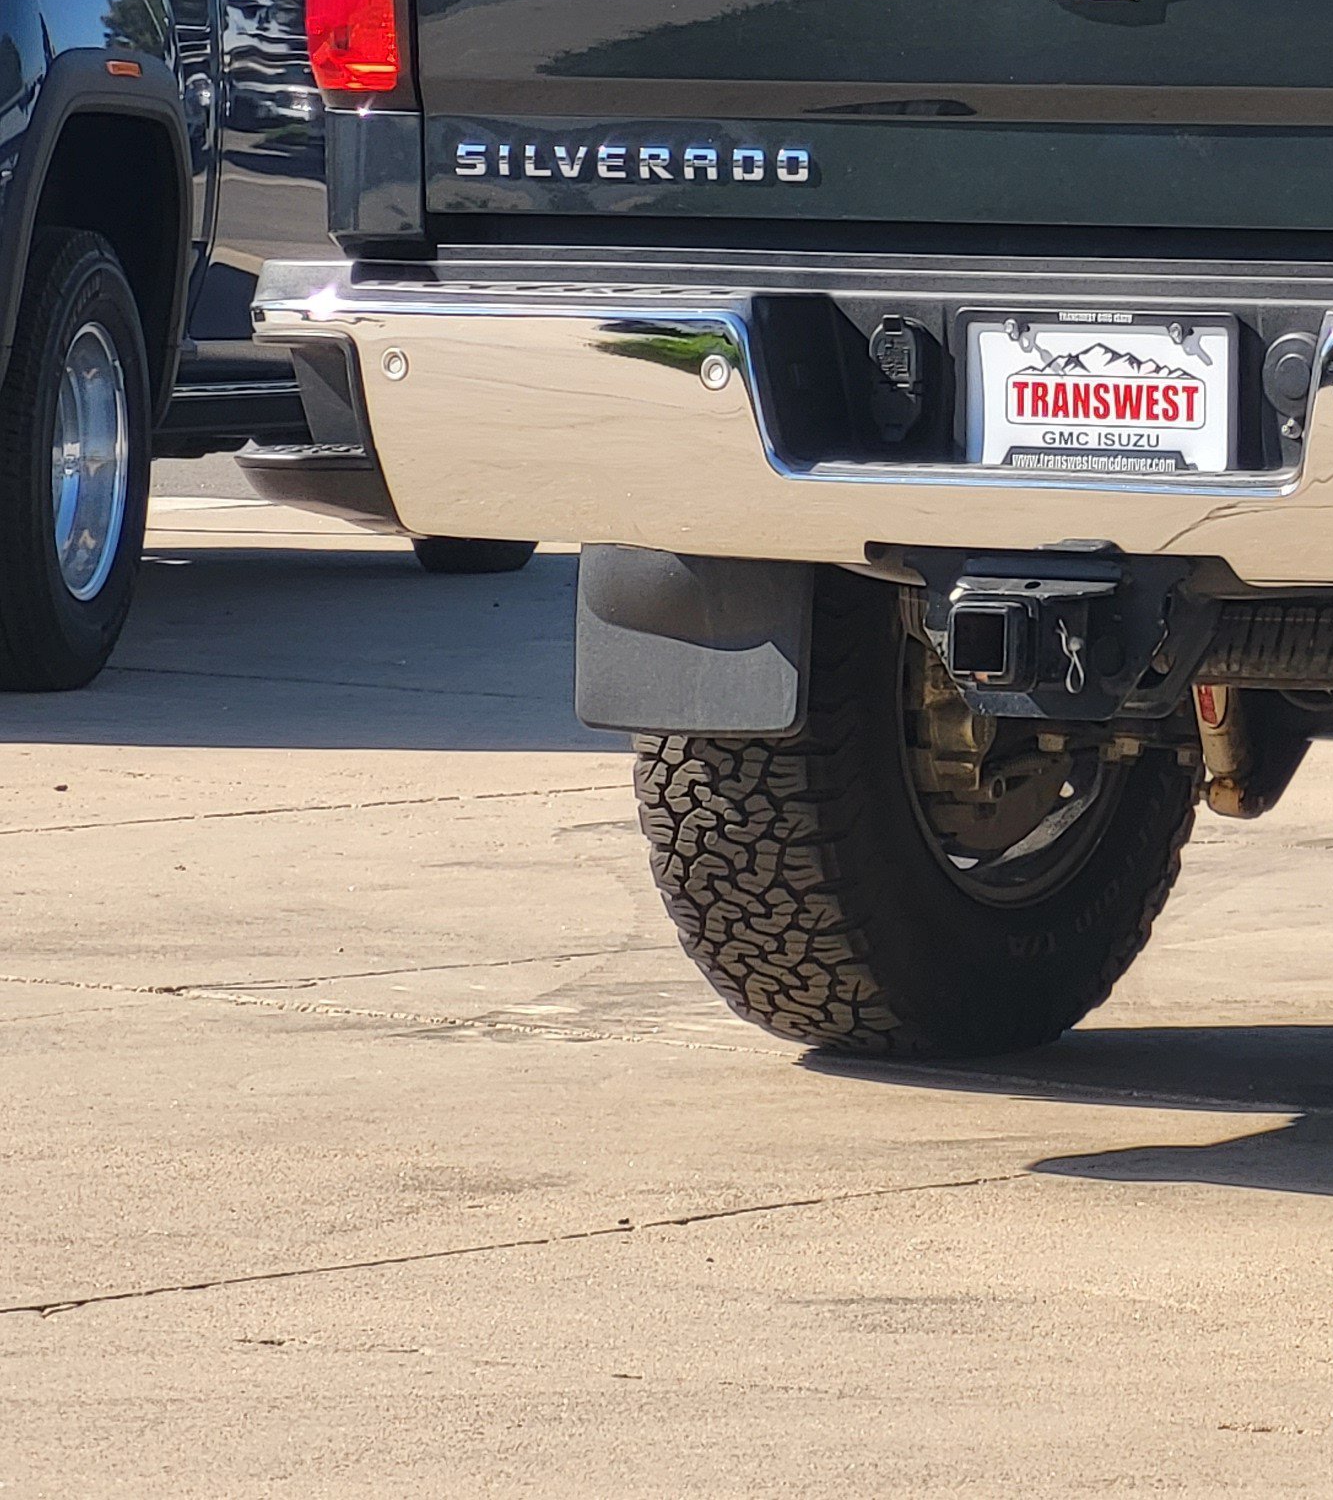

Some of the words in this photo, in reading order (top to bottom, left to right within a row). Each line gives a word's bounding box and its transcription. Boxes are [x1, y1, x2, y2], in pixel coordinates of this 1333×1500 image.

[455, 143, 811, 182] SILVERADO
[1011, 381, 1200, 422] TRANSWEST
[1042, 430, 1089, 447] GMC
[1097, 432, 1160, 449] ISUZU
